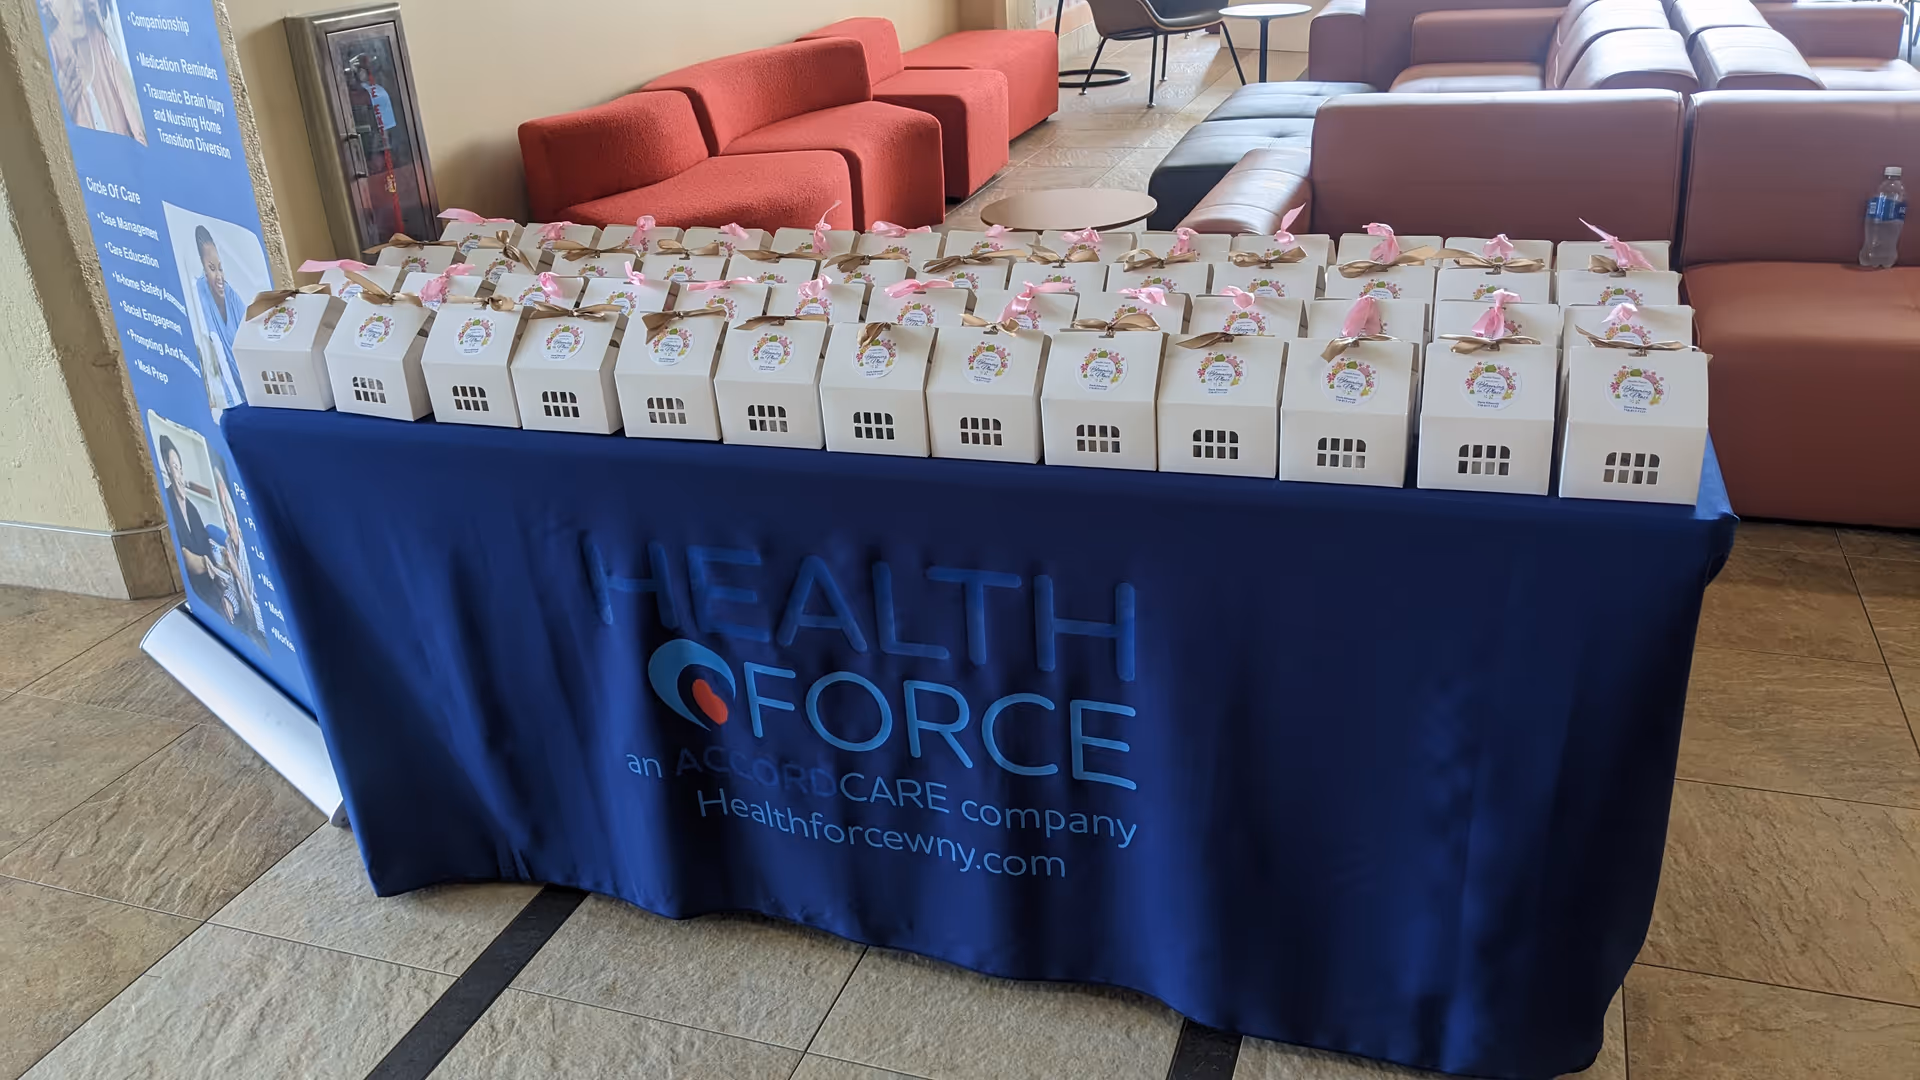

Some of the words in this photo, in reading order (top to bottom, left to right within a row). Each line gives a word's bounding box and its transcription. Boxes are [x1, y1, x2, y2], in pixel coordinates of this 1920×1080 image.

[130, 11, 190, 37] Companionship
[139, 51, 181, 73] Medication
[180, 58, 219, 81] Reminders
[145, 82, 183, 104] Traumatic
[183, 90, 207, 109] Brain
[205, 94, 225, 117] Injury
[153, 108, 167, 123] and
[166, 109, 200, 133] Nursing
[199, 115, 222, 135] Home
[157, 127, 196, 150] Transition
[195, 136, 232, 160] Diversion
[86, 176, 108, 196] Circle
[108, 183, 120, 199] Of
[120, 185, 141, 205] Care
[100, 211, 117, 228] Case
[116, 216, 160, 242] Management
[108, 241, 123, 257] Care
[122, 246, 160, 269] Education
[140, 279, 163, 301] Safety
[122, 300, 143, 319] Social
[142, 308, 183, 336] Engagement
[129, 328, 164, 356] Prompting
[164, 343, 180, 359] And
[137, 358, 152, 376] Meal
[151, 365, 169, 385] Prep
[582, 533, 1137, 682] HEALTH
[742, 660, 1138, 792] FORCE
[624, 751, 663, 780] an
[675, 743, 950, 816] ACCORDCARE
[960, 798, 1138, 849] company
[697, 788, 1067, 879] Healthforcewny.com
